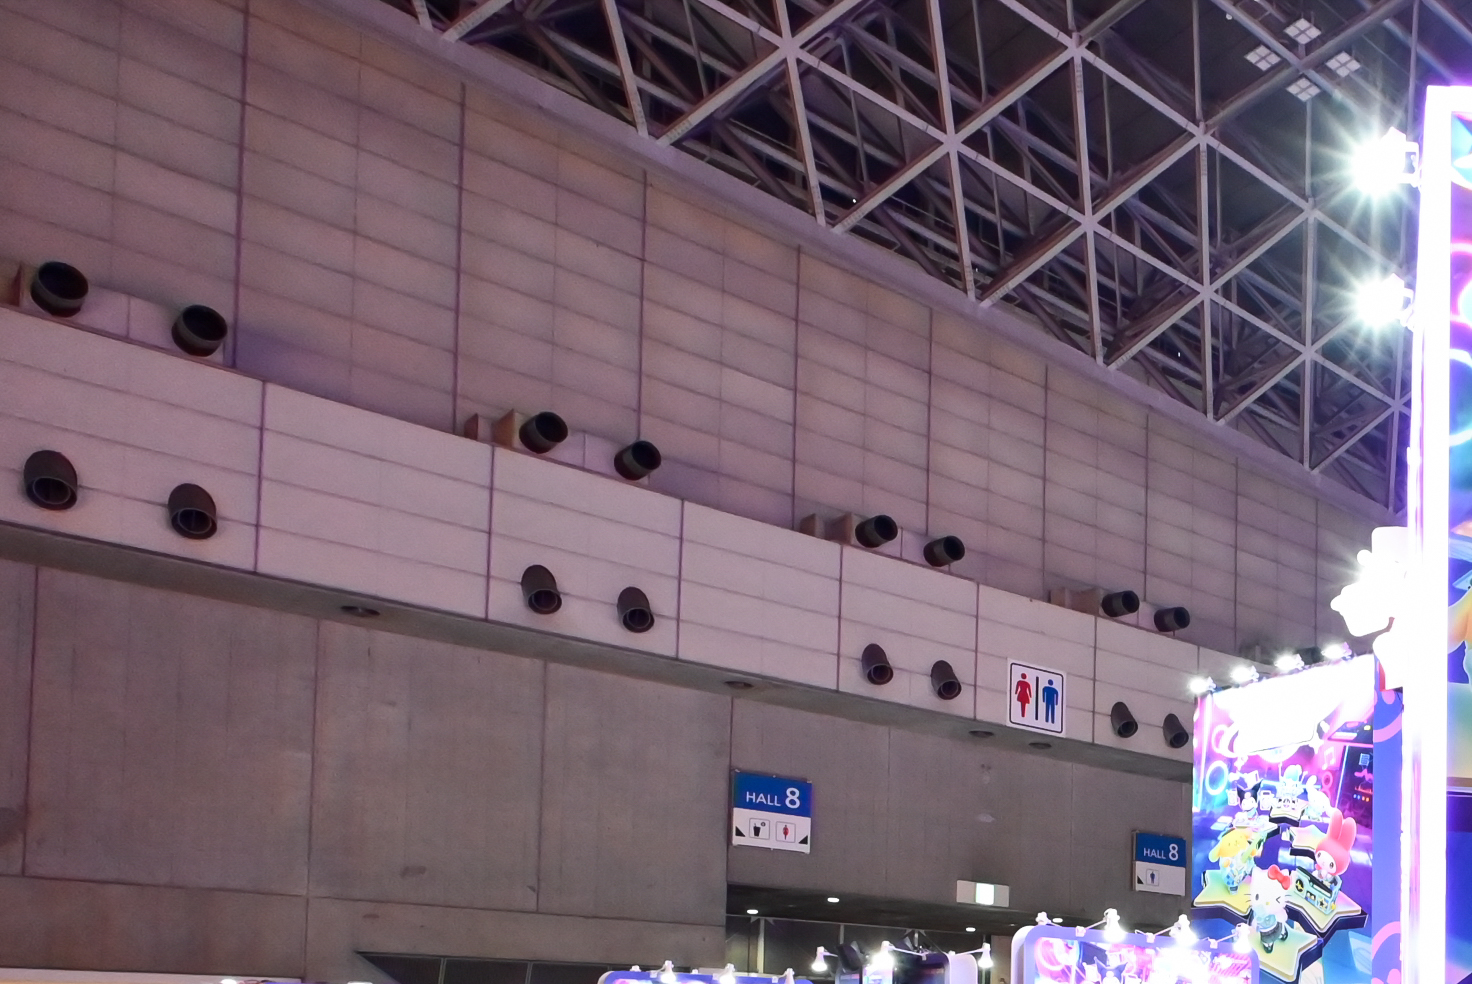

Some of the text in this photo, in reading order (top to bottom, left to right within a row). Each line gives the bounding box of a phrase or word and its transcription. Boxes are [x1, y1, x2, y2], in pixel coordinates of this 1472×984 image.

[746, 787, 801, 809] HALL 8
[1143, 843, 1179, 861] HALL 8
